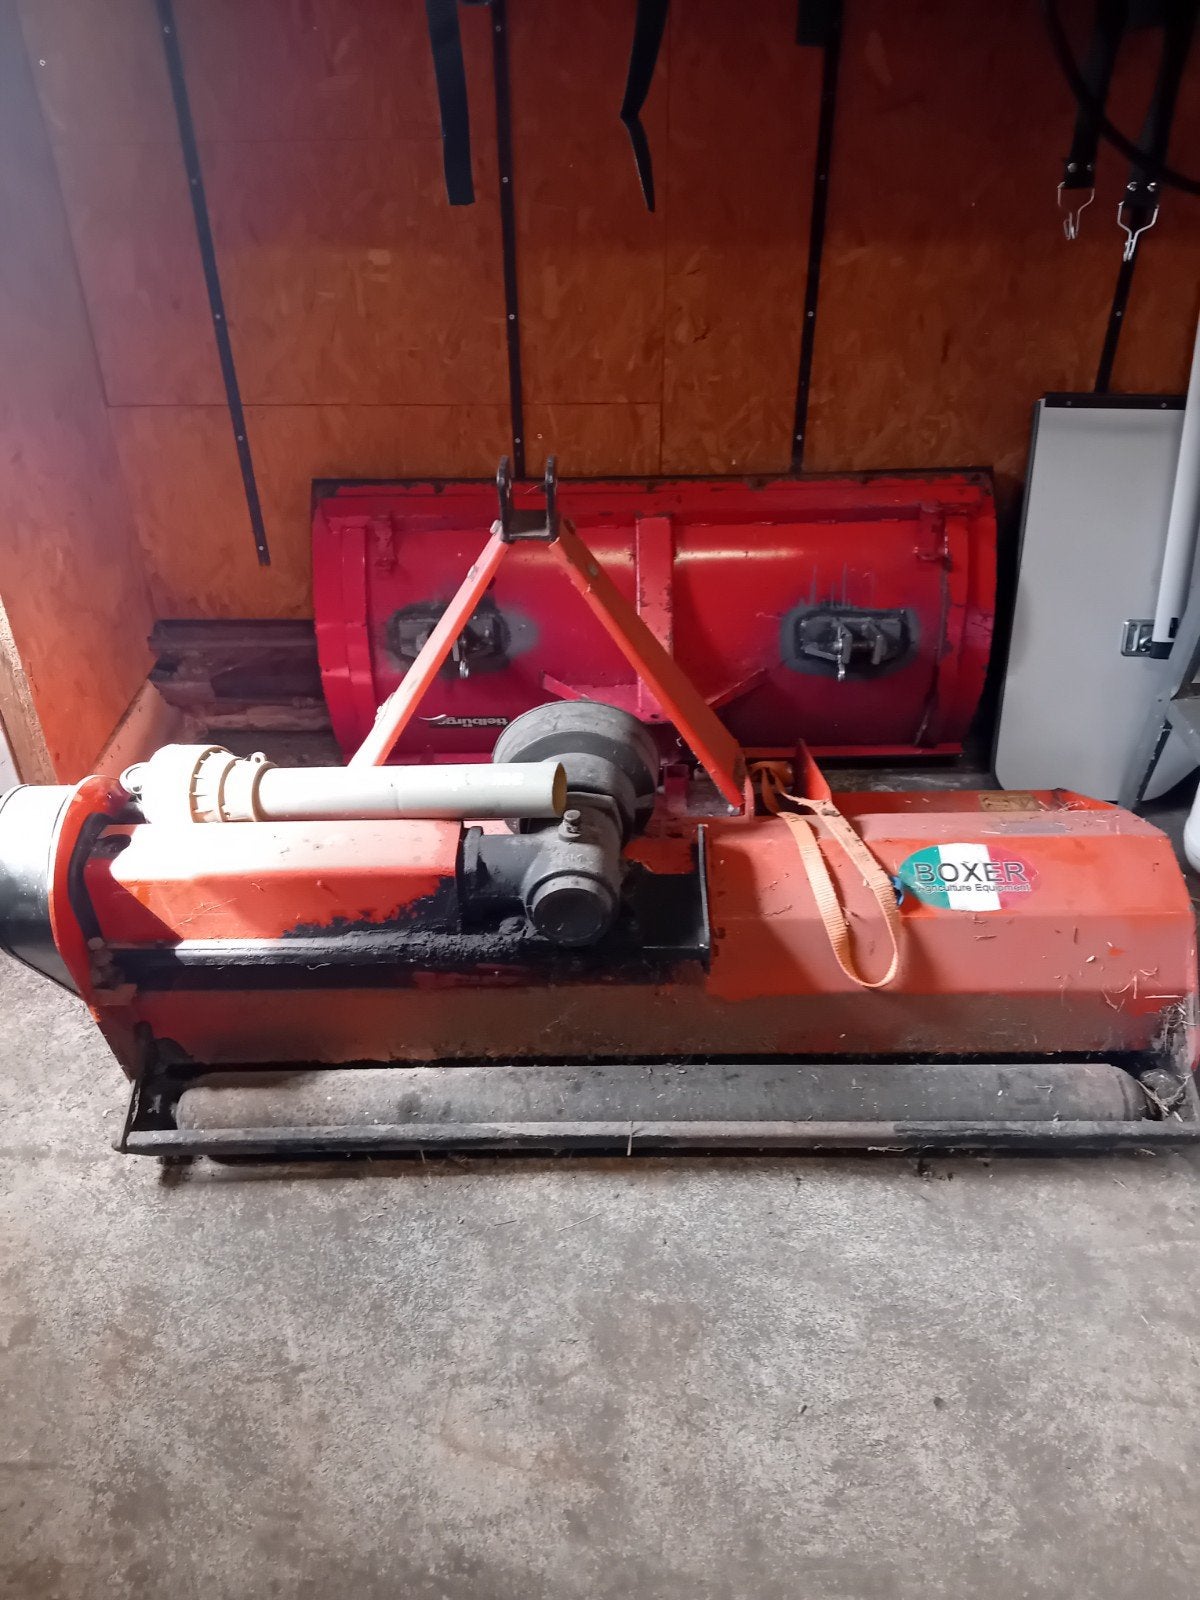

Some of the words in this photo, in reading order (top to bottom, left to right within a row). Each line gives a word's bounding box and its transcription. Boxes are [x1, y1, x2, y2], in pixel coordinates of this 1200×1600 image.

[914, 862, 1028, 882] BOXER
[916, 883, 972, 893] Agriculture
[975, 883, 1031, 893] Equipment
